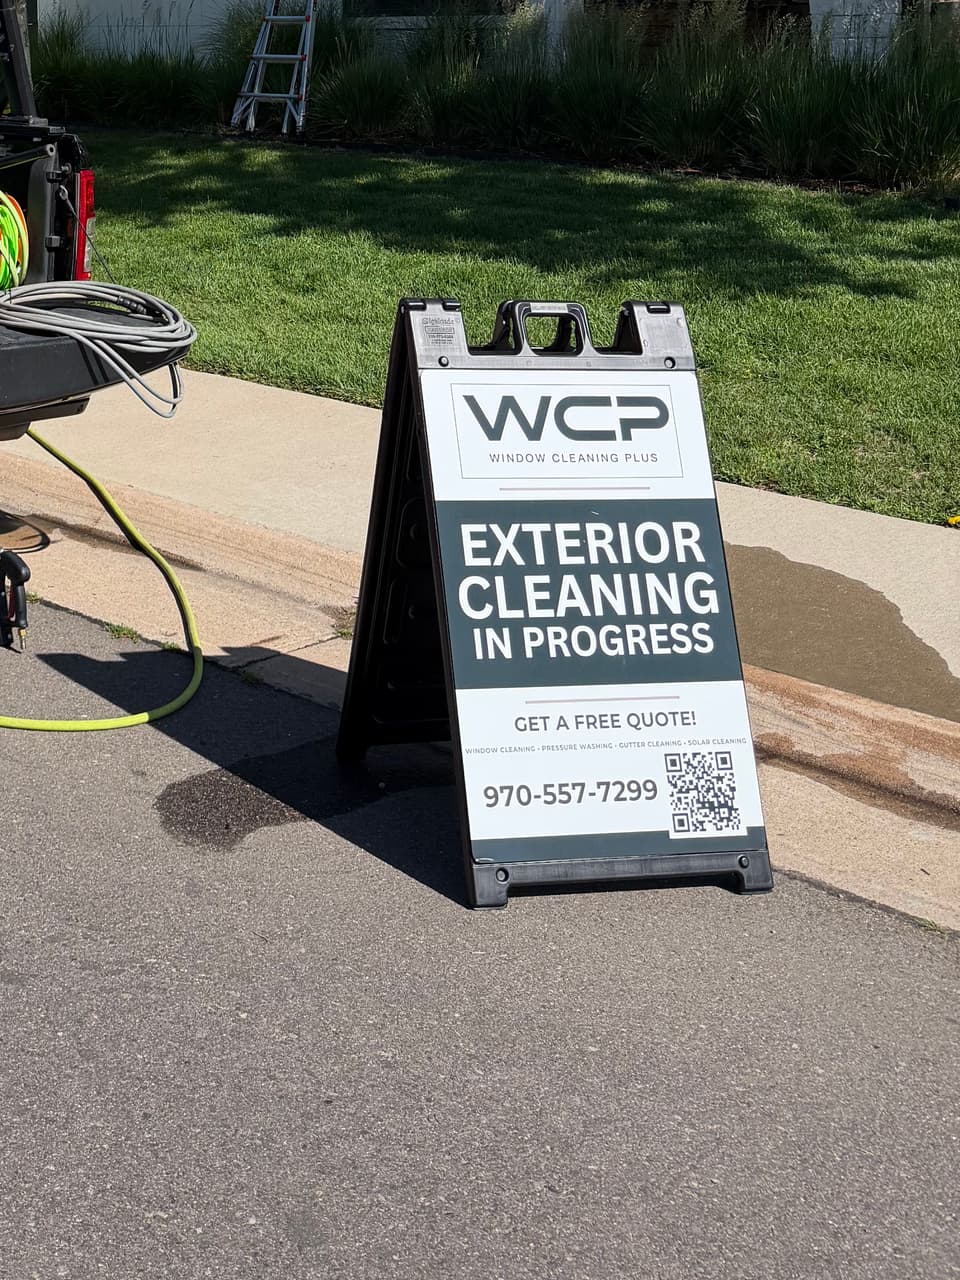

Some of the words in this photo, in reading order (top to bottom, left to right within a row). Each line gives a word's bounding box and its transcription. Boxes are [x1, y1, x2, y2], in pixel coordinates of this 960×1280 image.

[462, 394, 669, 441] WCP
[489, 453, 546, 463] WINDOW
[551, 453, 619, 463] CLEANING
[625, 453, 658, 463] PLUS
[460, 521, 706, 566] EXTERIOR
[458, 571, 720, 620] CLEANING
[473, 627, 512, 660] IN
[523, 622, 714, 659] PROGRESS
[514, 716, 550, 732] GET
[556, 715, 570, 730] A
[574, 713, 621, 730] FREE
[626, 711, 696, 730] QUOTE!
[500, 745, 536, 753] CLEANING
[541, 743, 578, 751] PRESSURE
[580, 742, 613, 750] WASHING
[619, 741, 646, 749] GUTTER
[647, 739, 682, 748] CLEANING
[687, 738, 711, 746] SOLAR
[712, 737, 747, 745] CLEANING
[483, 779, 658, 808] 970-557-7299
